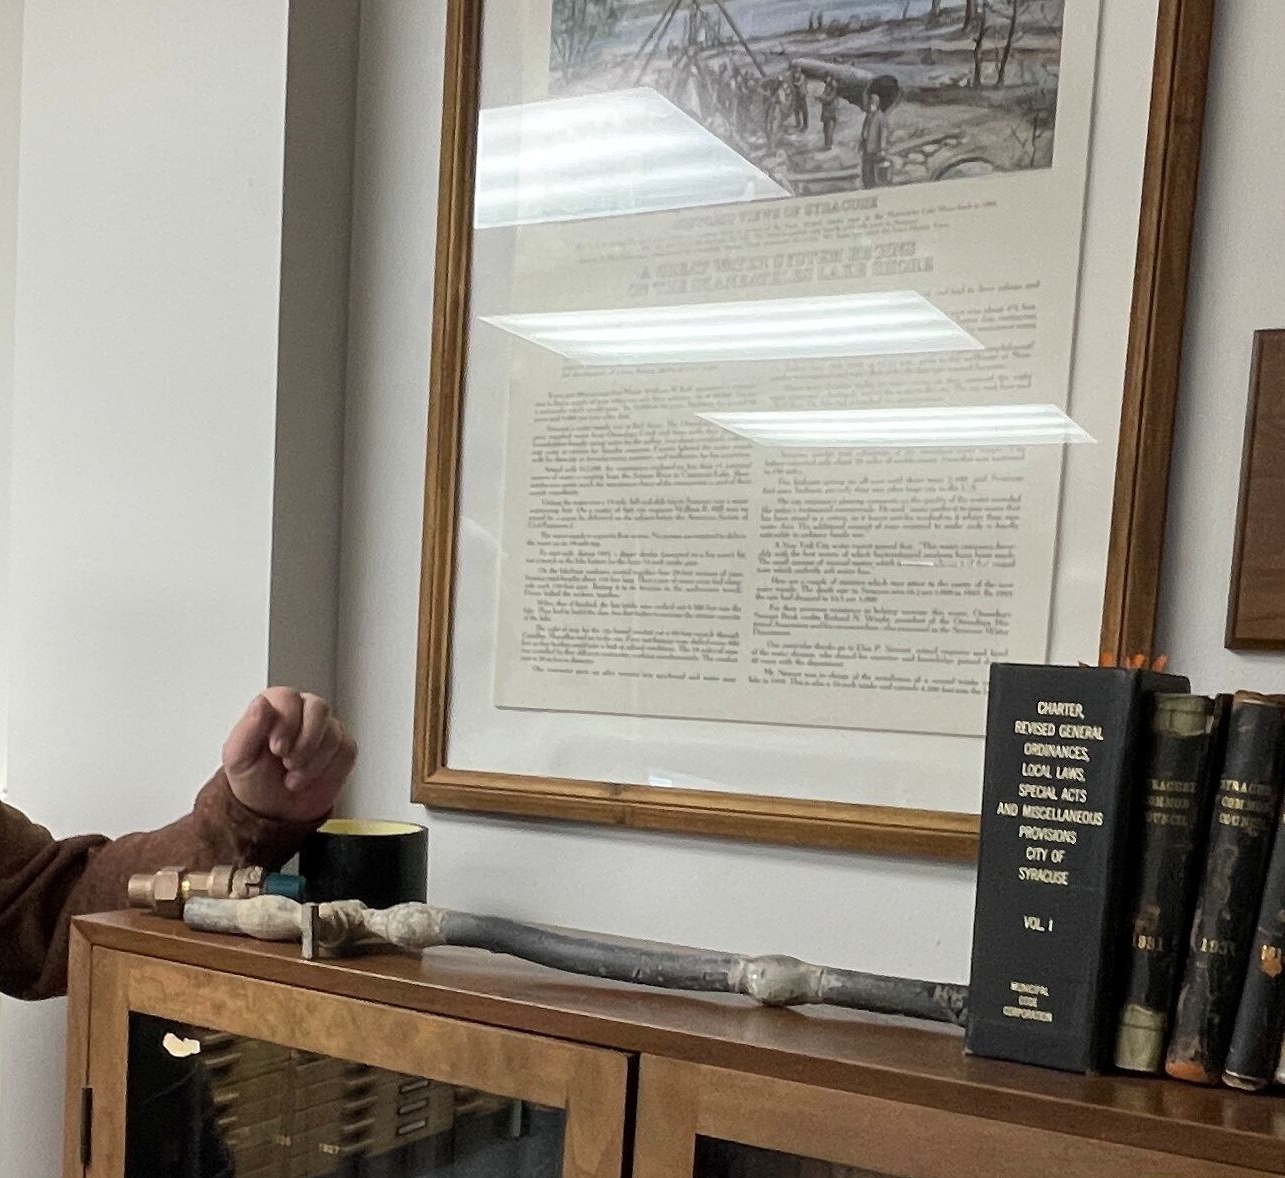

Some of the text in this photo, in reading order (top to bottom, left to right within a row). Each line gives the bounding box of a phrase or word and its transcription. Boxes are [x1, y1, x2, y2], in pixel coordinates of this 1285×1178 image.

[1014, 720, 1104, 742] REVISED GENERAL
[1021, 762, 1053, 780] LOCAL
[1018, 783, 1088, 804] SPECIAL ACTS
[996, 801, 1105, 827] AND MISCELLANEOUS
[1018, 825, 1078, 846] PROVISIONS
[1026, 846, 1067, 864] CITY OF
[1018, 866, 1069, 886] SYRACUSE
